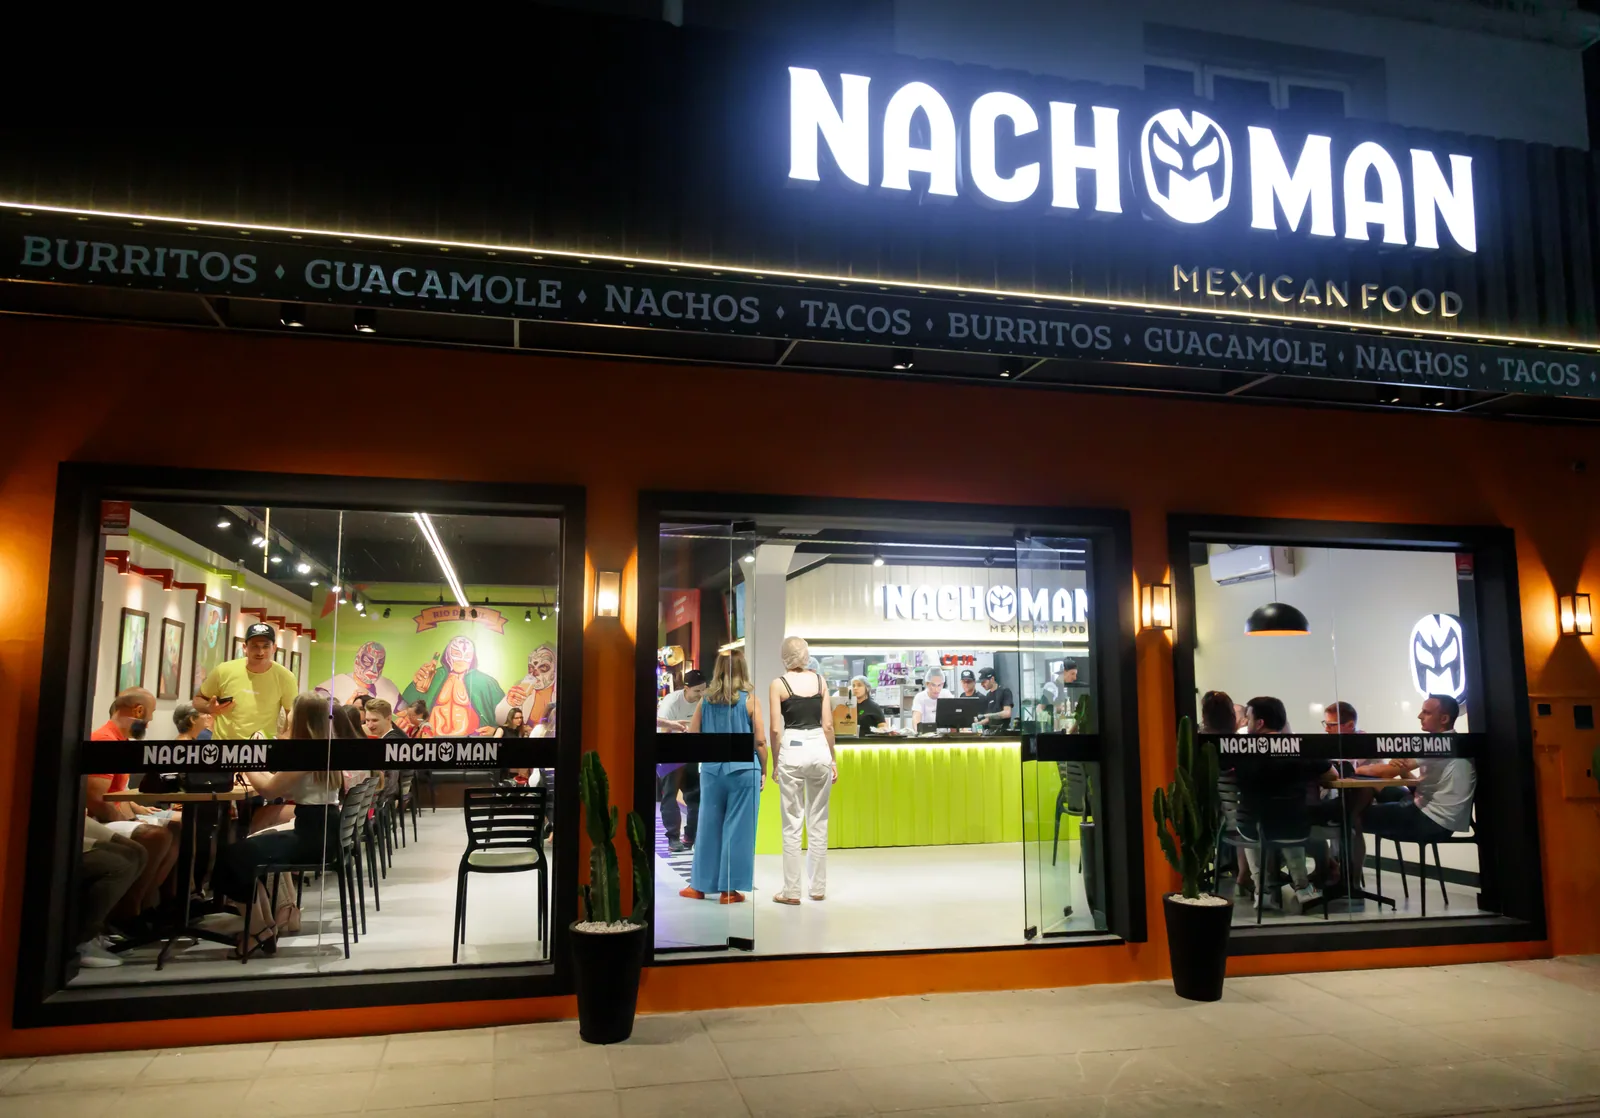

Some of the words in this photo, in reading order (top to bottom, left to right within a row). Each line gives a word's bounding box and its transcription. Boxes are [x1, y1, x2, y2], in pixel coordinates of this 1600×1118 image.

[20, 235, 258, 285] BURRITOS
[304, 259, 563, 309] GUACAMOLE
[604, 284, 761, 324] NACHOS
[800, 300, 912, 336] TACOS
[948, 311, 1112, 351] BURRITOS
[1143, 326, 1328, 368] GUACAMOLE
[1355, 343, 1469, 379] NACHOS
[1497, 358, 1581, 388] TACOS
[1172, 263, 1349, 308] MEXICAN
[1361, 282, 1464, 319] FOOD
[942, 653, 974, 666] CAJA
